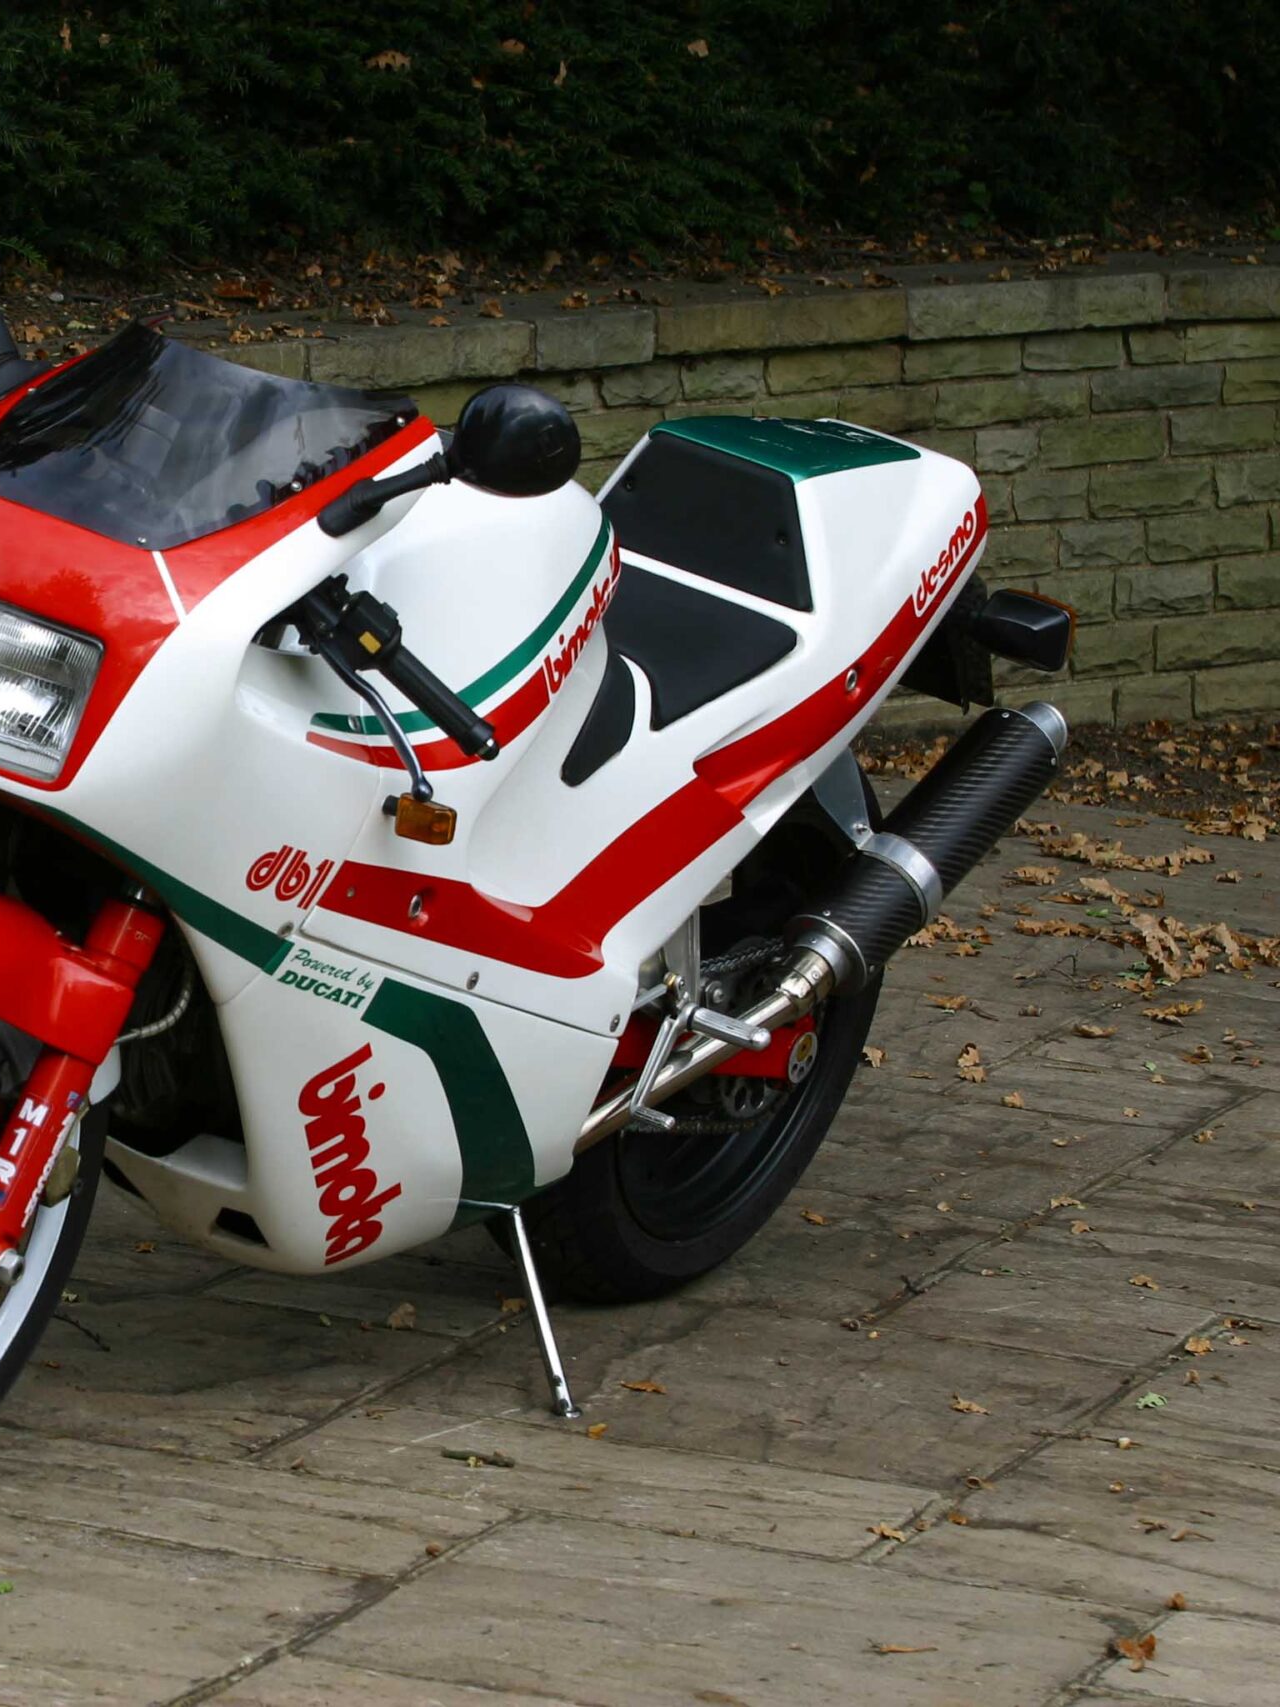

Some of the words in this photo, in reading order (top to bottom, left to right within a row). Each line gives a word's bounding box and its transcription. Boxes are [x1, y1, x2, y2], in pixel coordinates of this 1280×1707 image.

[916, 511, 974, 611] desmo
[277, 969, 366, 1009] DUCATI
[291, 949, 357, 982] Powered
[357, 972, 375, 993] by
